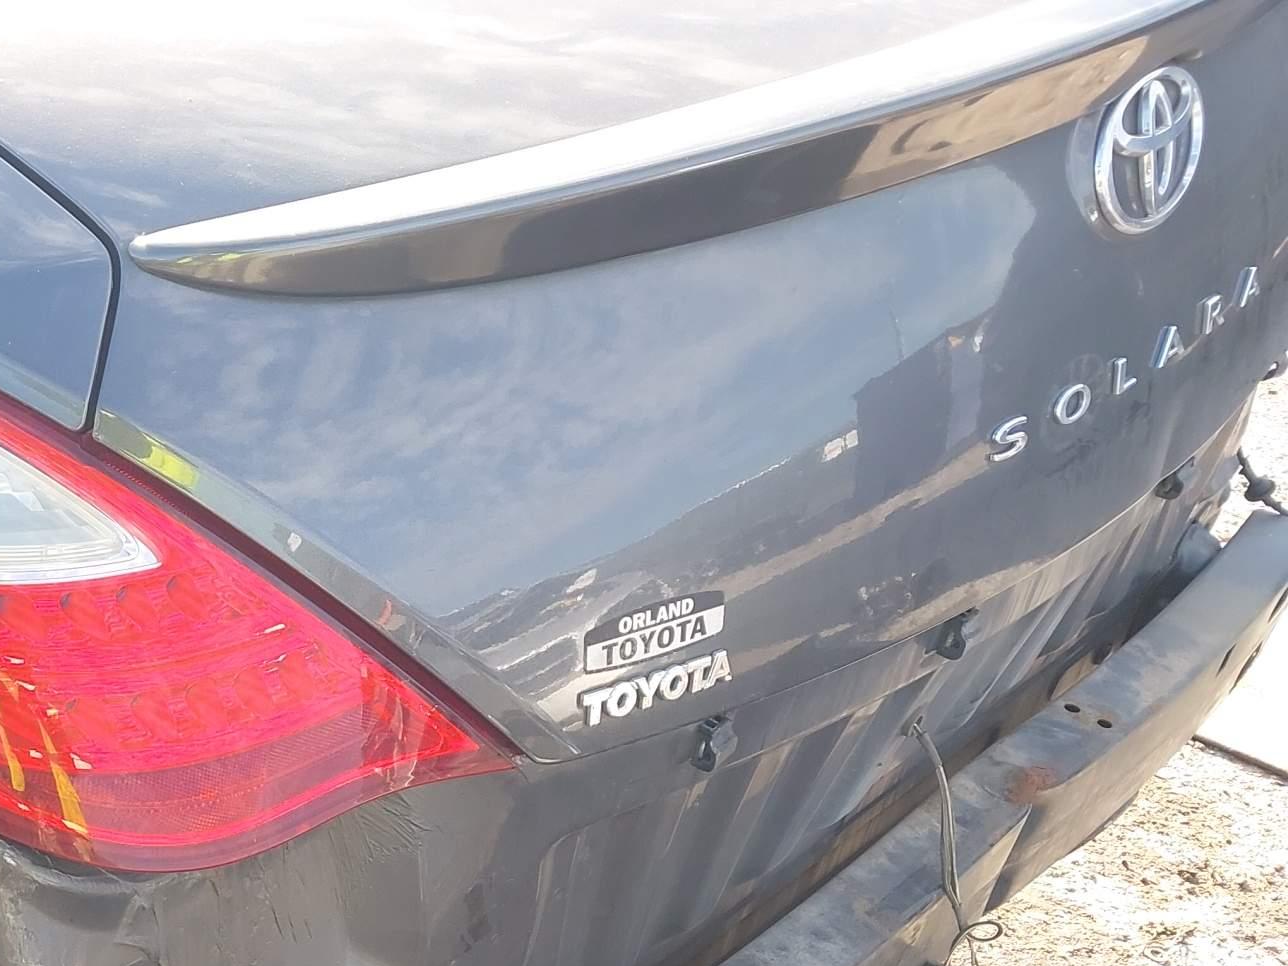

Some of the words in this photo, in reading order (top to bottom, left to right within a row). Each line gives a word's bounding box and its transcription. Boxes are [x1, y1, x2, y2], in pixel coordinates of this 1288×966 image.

[985, 265, 1261, 462] SOLARA
[601, 615, 708, 666] TOYOTA
[618, 597, 695, 633] ORLAND
[580, 649, 733, 726] TOYOTA
